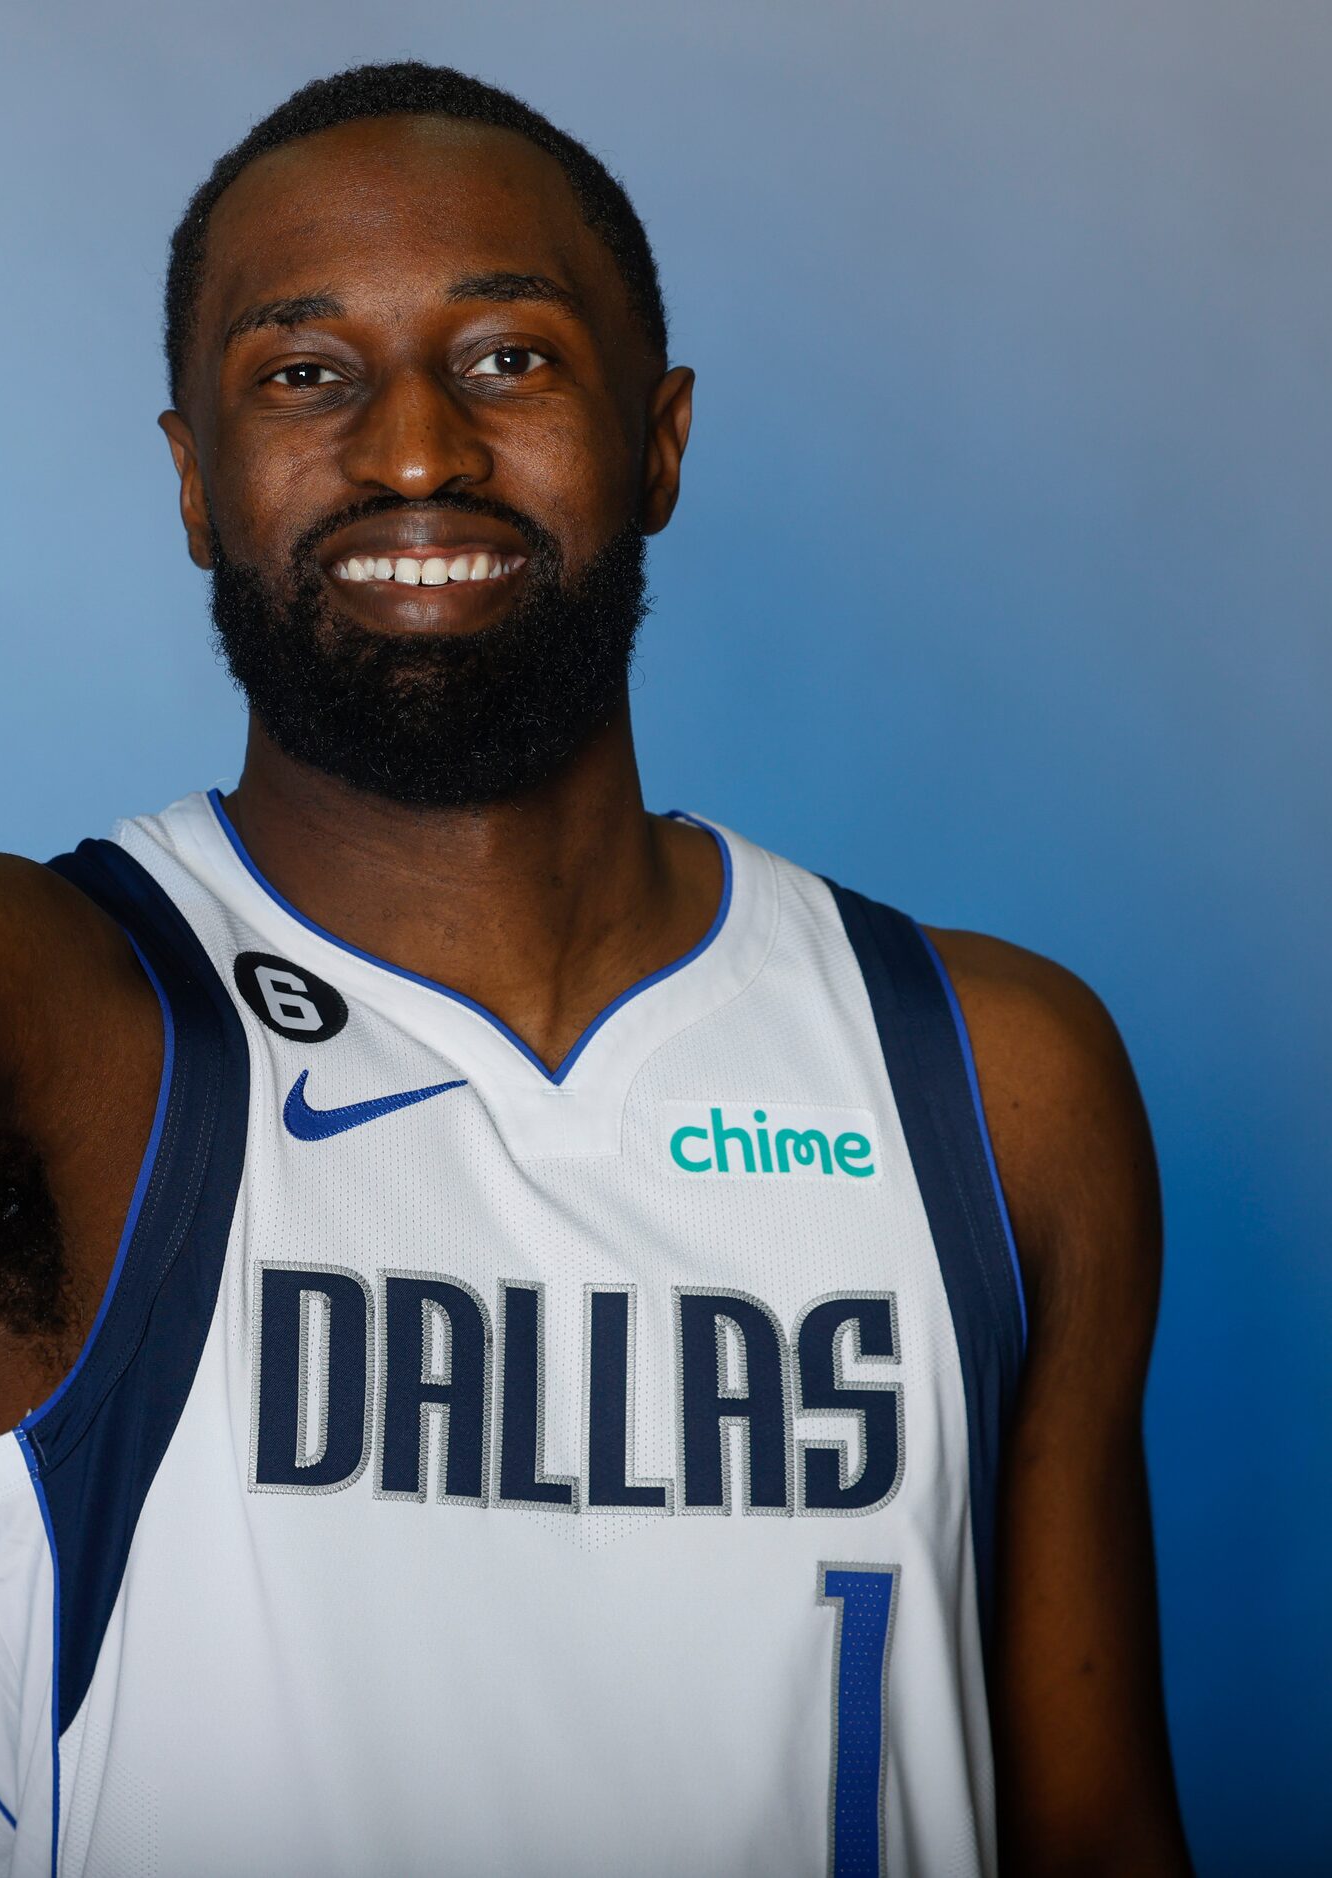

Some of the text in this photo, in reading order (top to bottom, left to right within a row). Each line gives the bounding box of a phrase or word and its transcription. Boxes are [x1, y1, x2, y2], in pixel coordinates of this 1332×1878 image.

[254, 965, 324, 1037] 6
[670, 1107, 875, 1178] chime
[248, 1259, 907, 1518] DALLAS
[816, 1560, 902, 1878] 1
